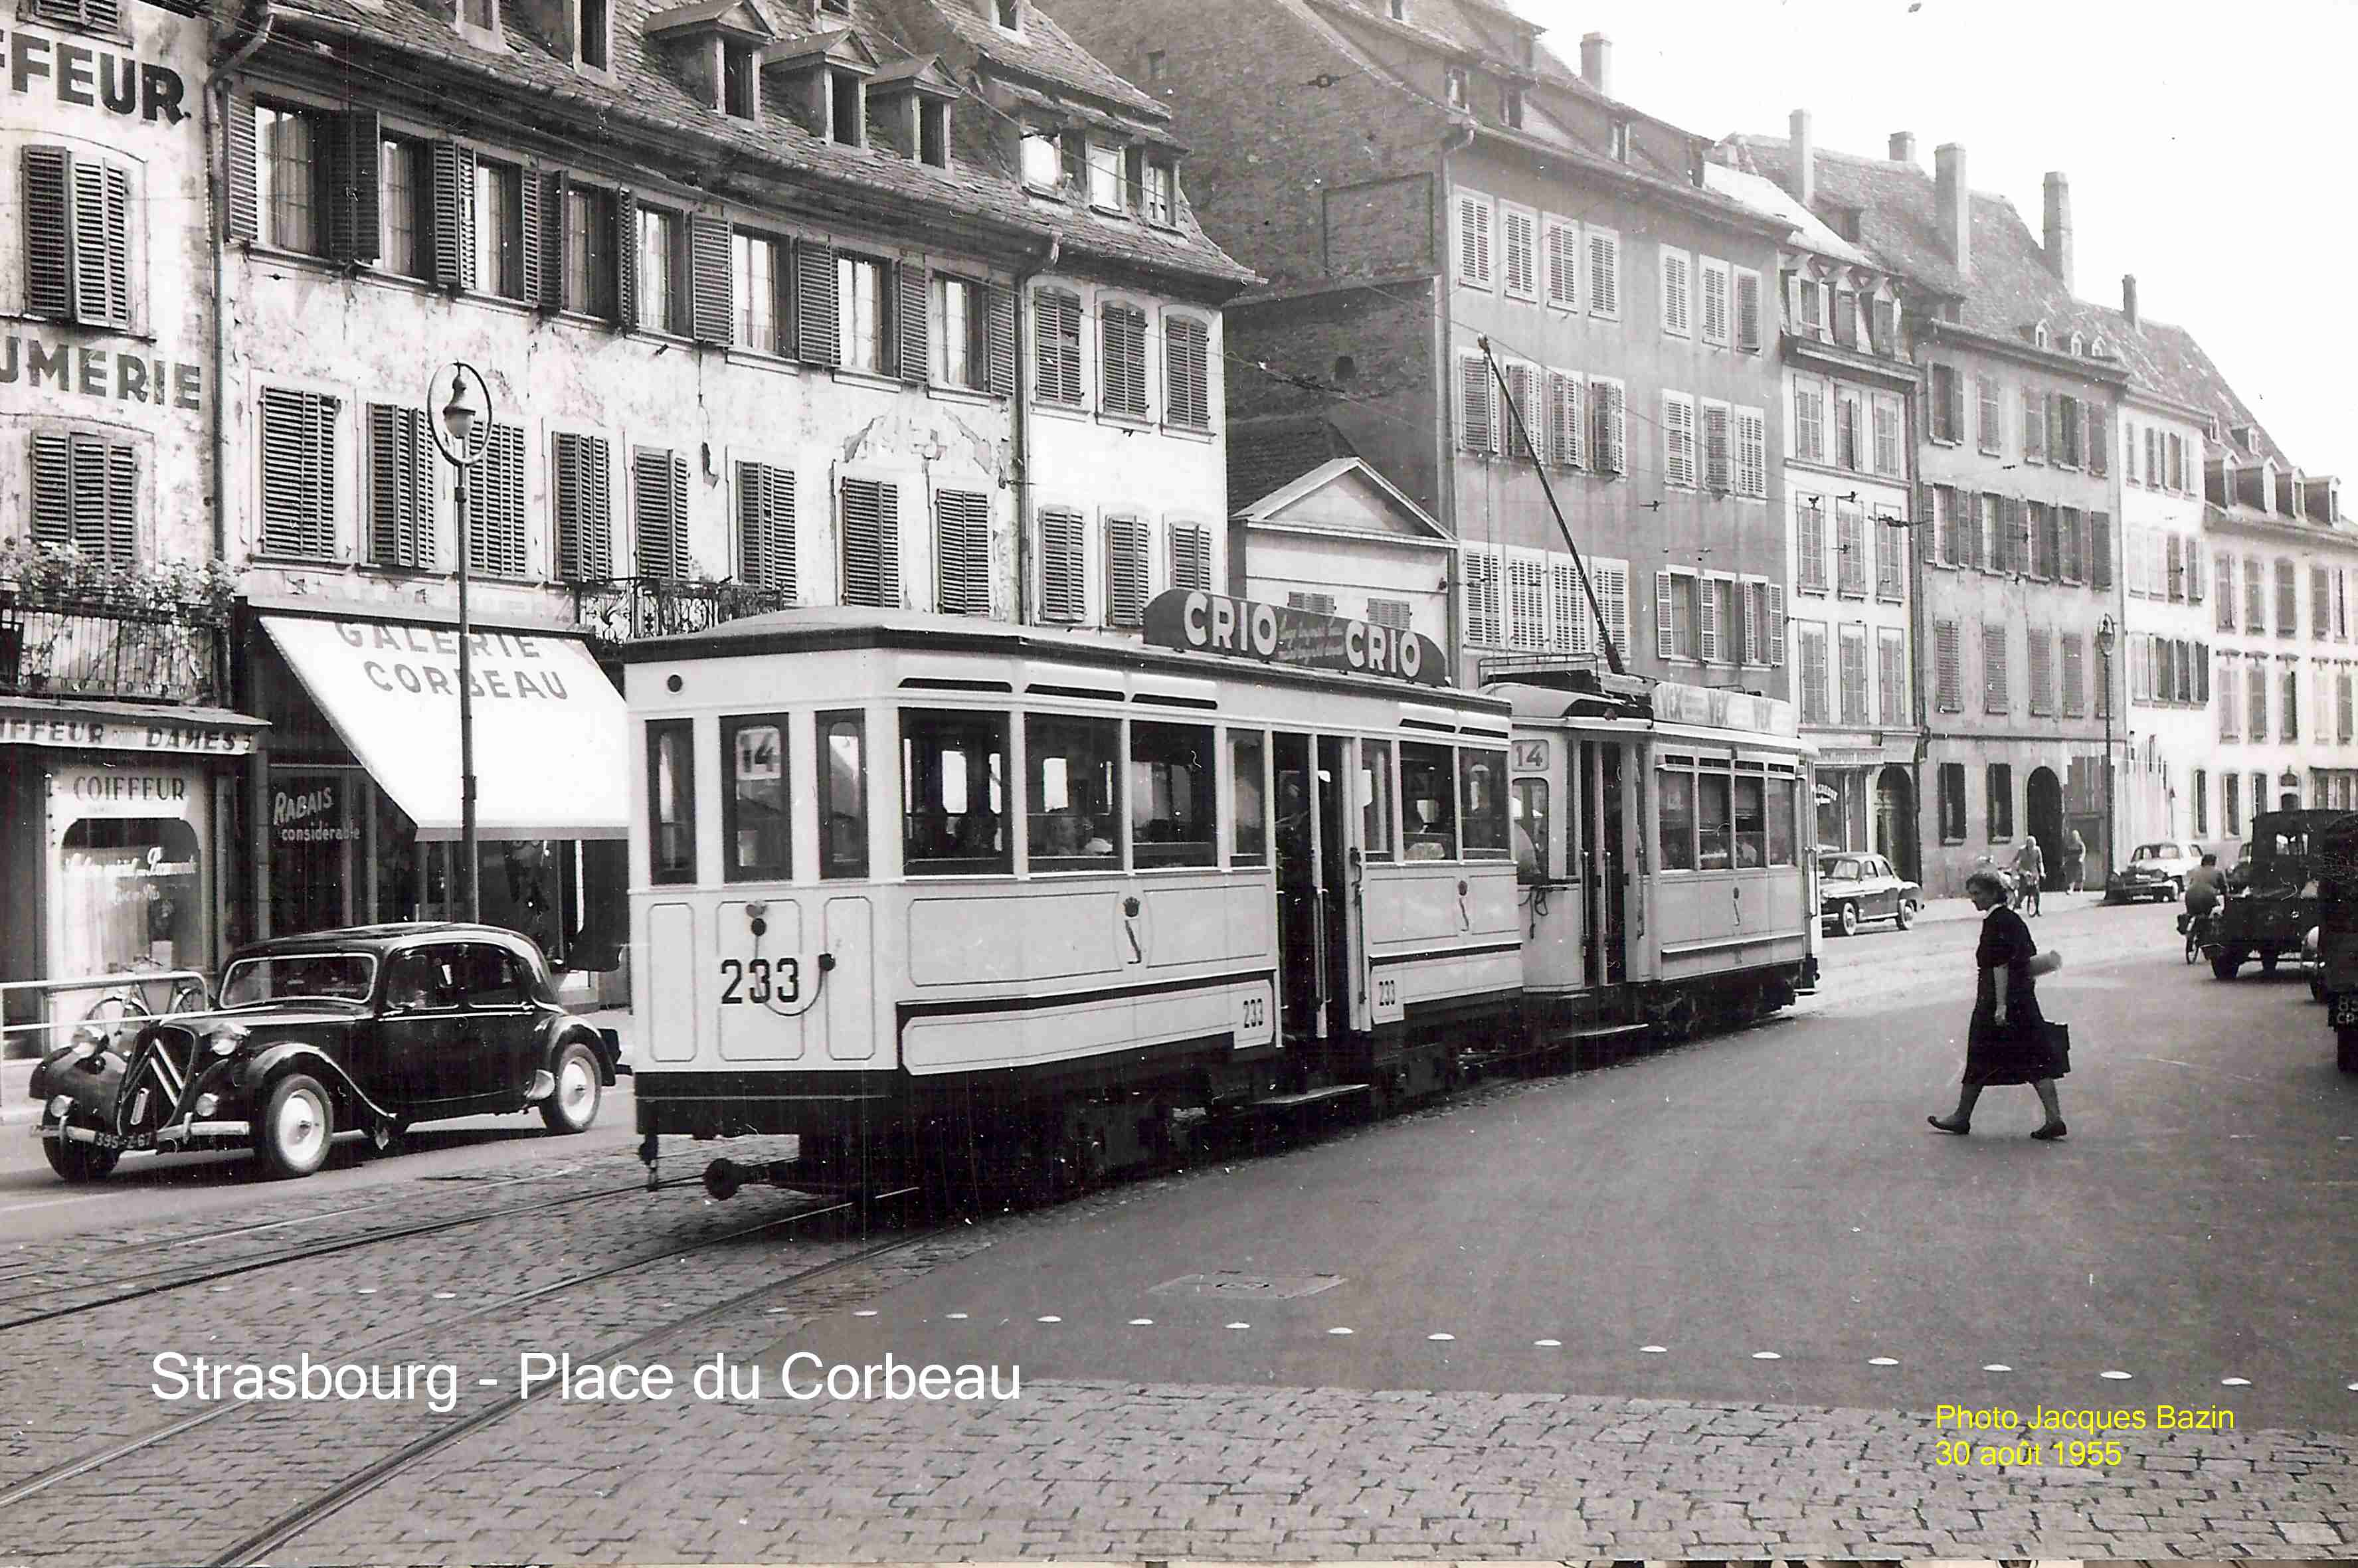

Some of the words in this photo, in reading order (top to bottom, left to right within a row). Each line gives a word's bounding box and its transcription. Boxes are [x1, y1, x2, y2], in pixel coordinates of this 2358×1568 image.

[0, 29, 186, 125] FEUR
[334, 622, 541, 658] GALERIE
[1180, 592, 1277, 655] CRIO
[1346, 620, 1421, 677] CRIO
[740, 733, 780, 772] 14
[1516, 744, 1543, 766] 14
[73, 775, 186, 801] COIFFEUR
[273, 786, 334, 826] RABAIS
[721, 958, 799, 1004] 233
[1379, 980, 1396, 1005] 233
[1243, 998, 1263, 1028] 233
